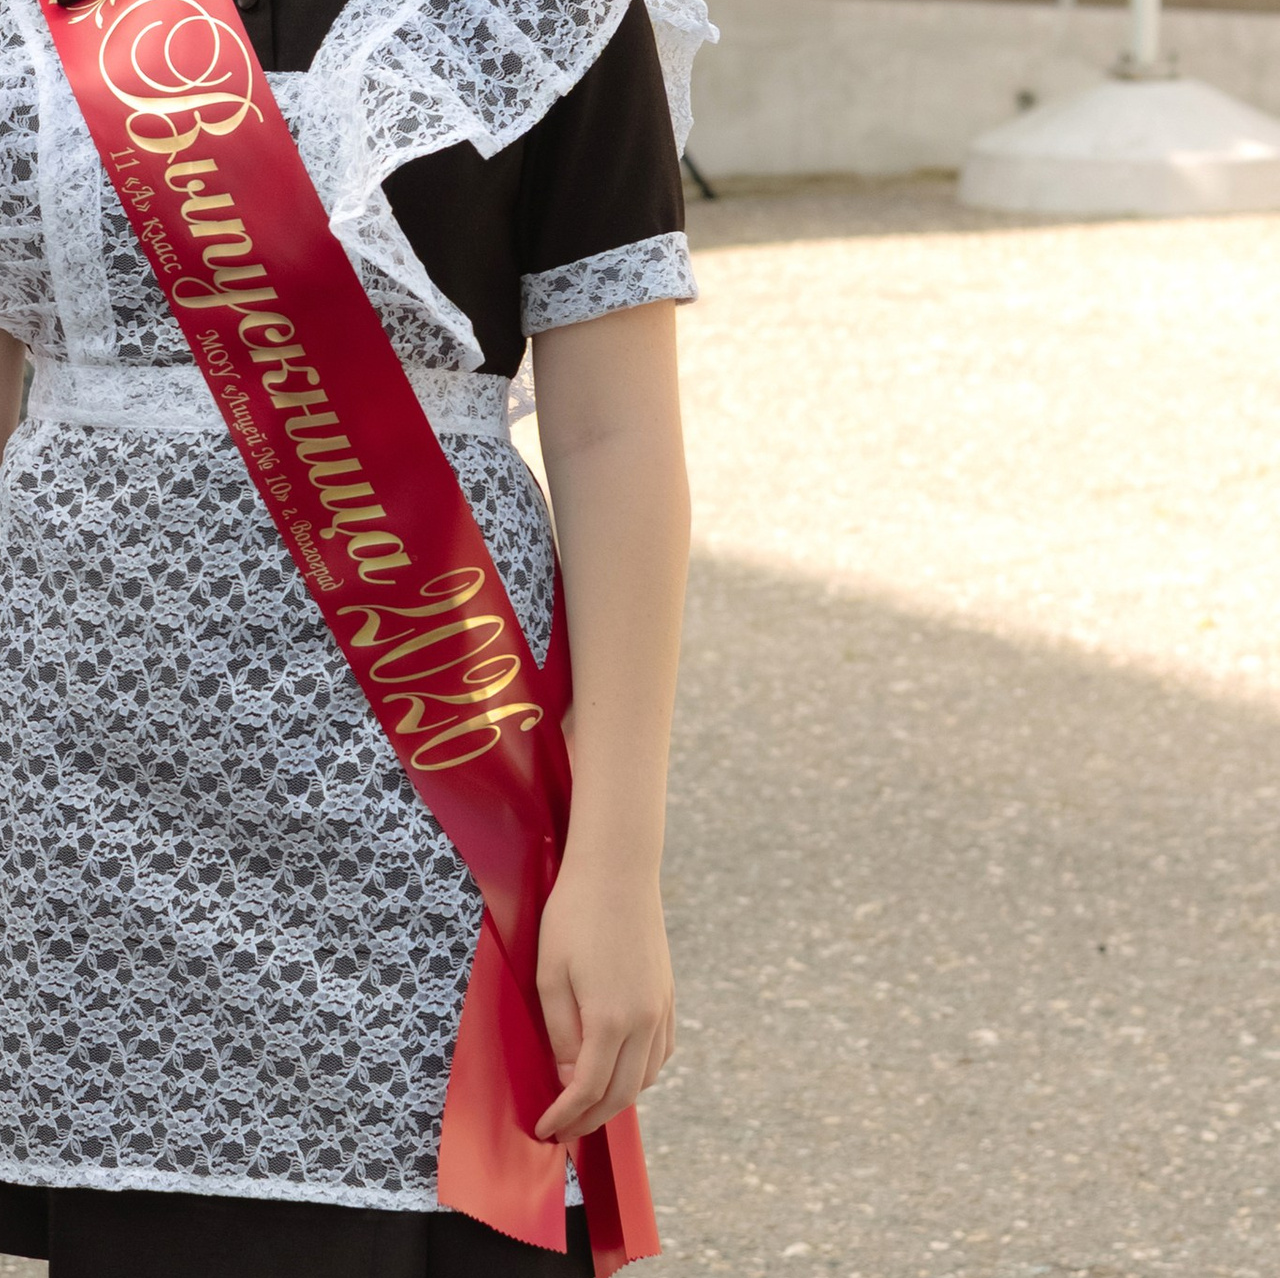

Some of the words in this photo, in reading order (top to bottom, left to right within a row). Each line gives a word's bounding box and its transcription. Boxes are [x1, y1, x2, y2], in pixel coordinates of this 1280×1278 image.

[110, 146, 140, 172] 11
[121, 177, 156, 213] «А»
[141, 216, 182, 274] класс
[196, 328, 241, 380] МОУ
[221, 383, 268, 448] «Лицей
[251, 446, 281, 472] №
[264, 473, 293, 503] 10»
[281, 507, 298, 521] г.
[290, 519, 345, 593] Волгоград
[336, 566, 544, 771] 2026
